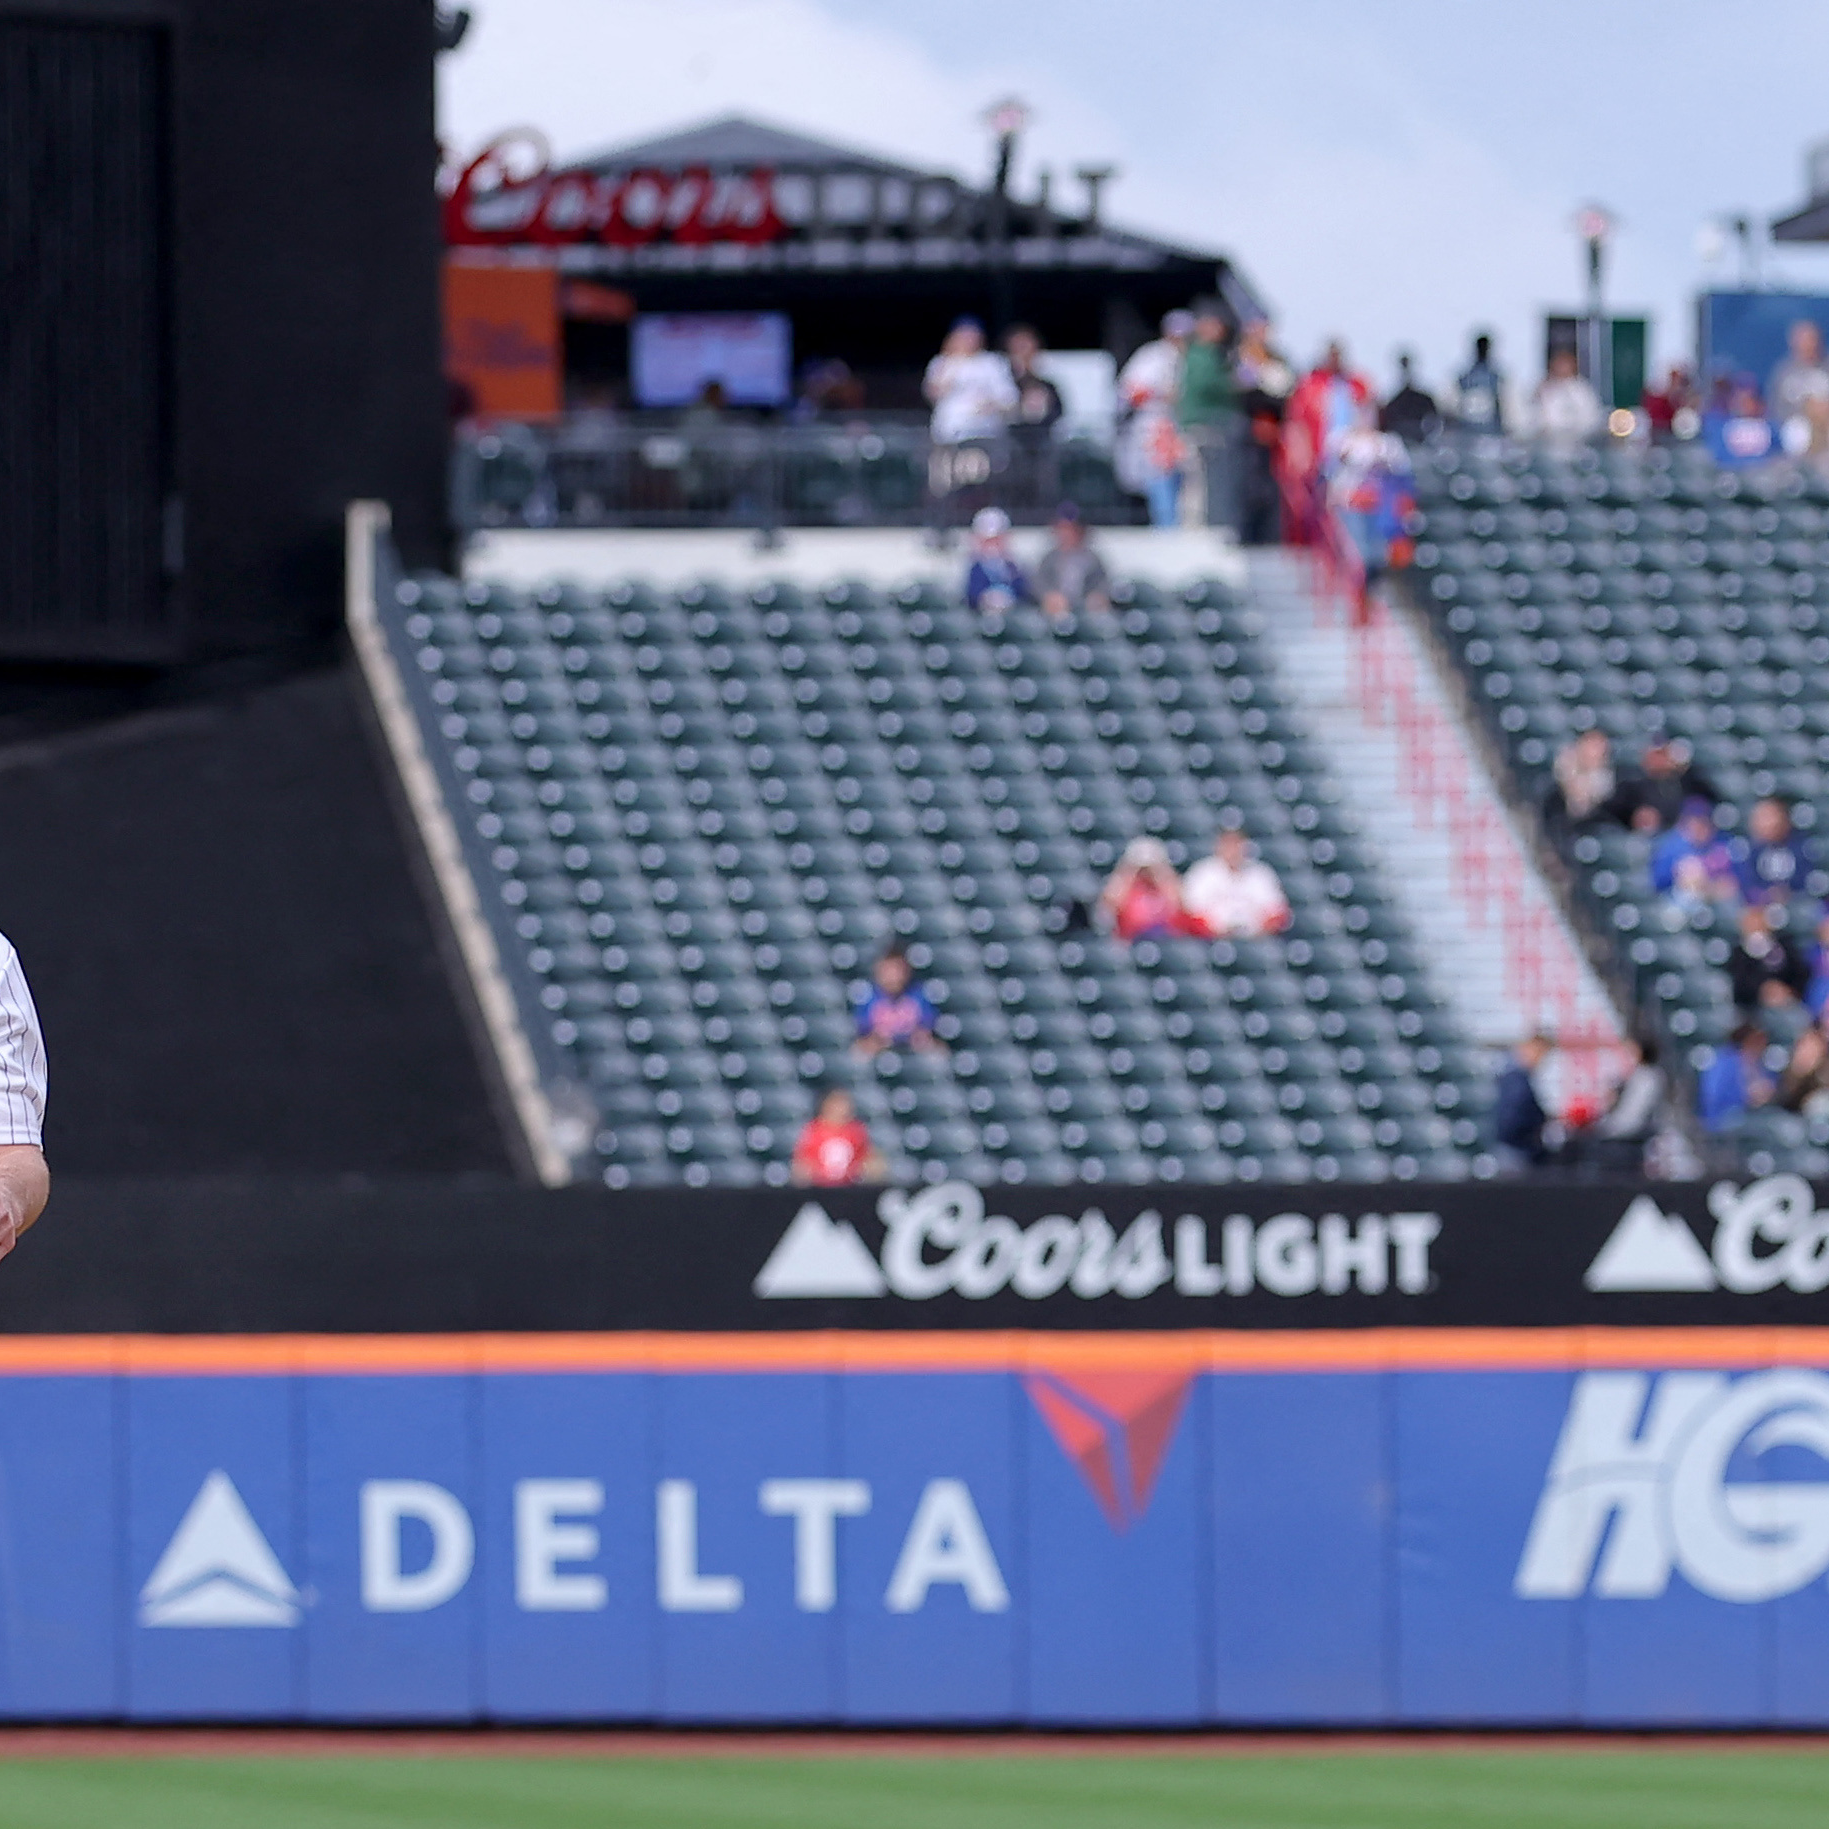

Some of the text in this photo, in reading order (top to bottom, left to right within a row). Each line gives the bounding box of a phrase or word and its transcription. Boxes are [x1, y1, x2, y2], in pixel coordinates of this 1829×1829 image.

[876, 1178, 1443, 1300] Coors LIGHT
[359, 1476, 1011, 1615] DELTA
